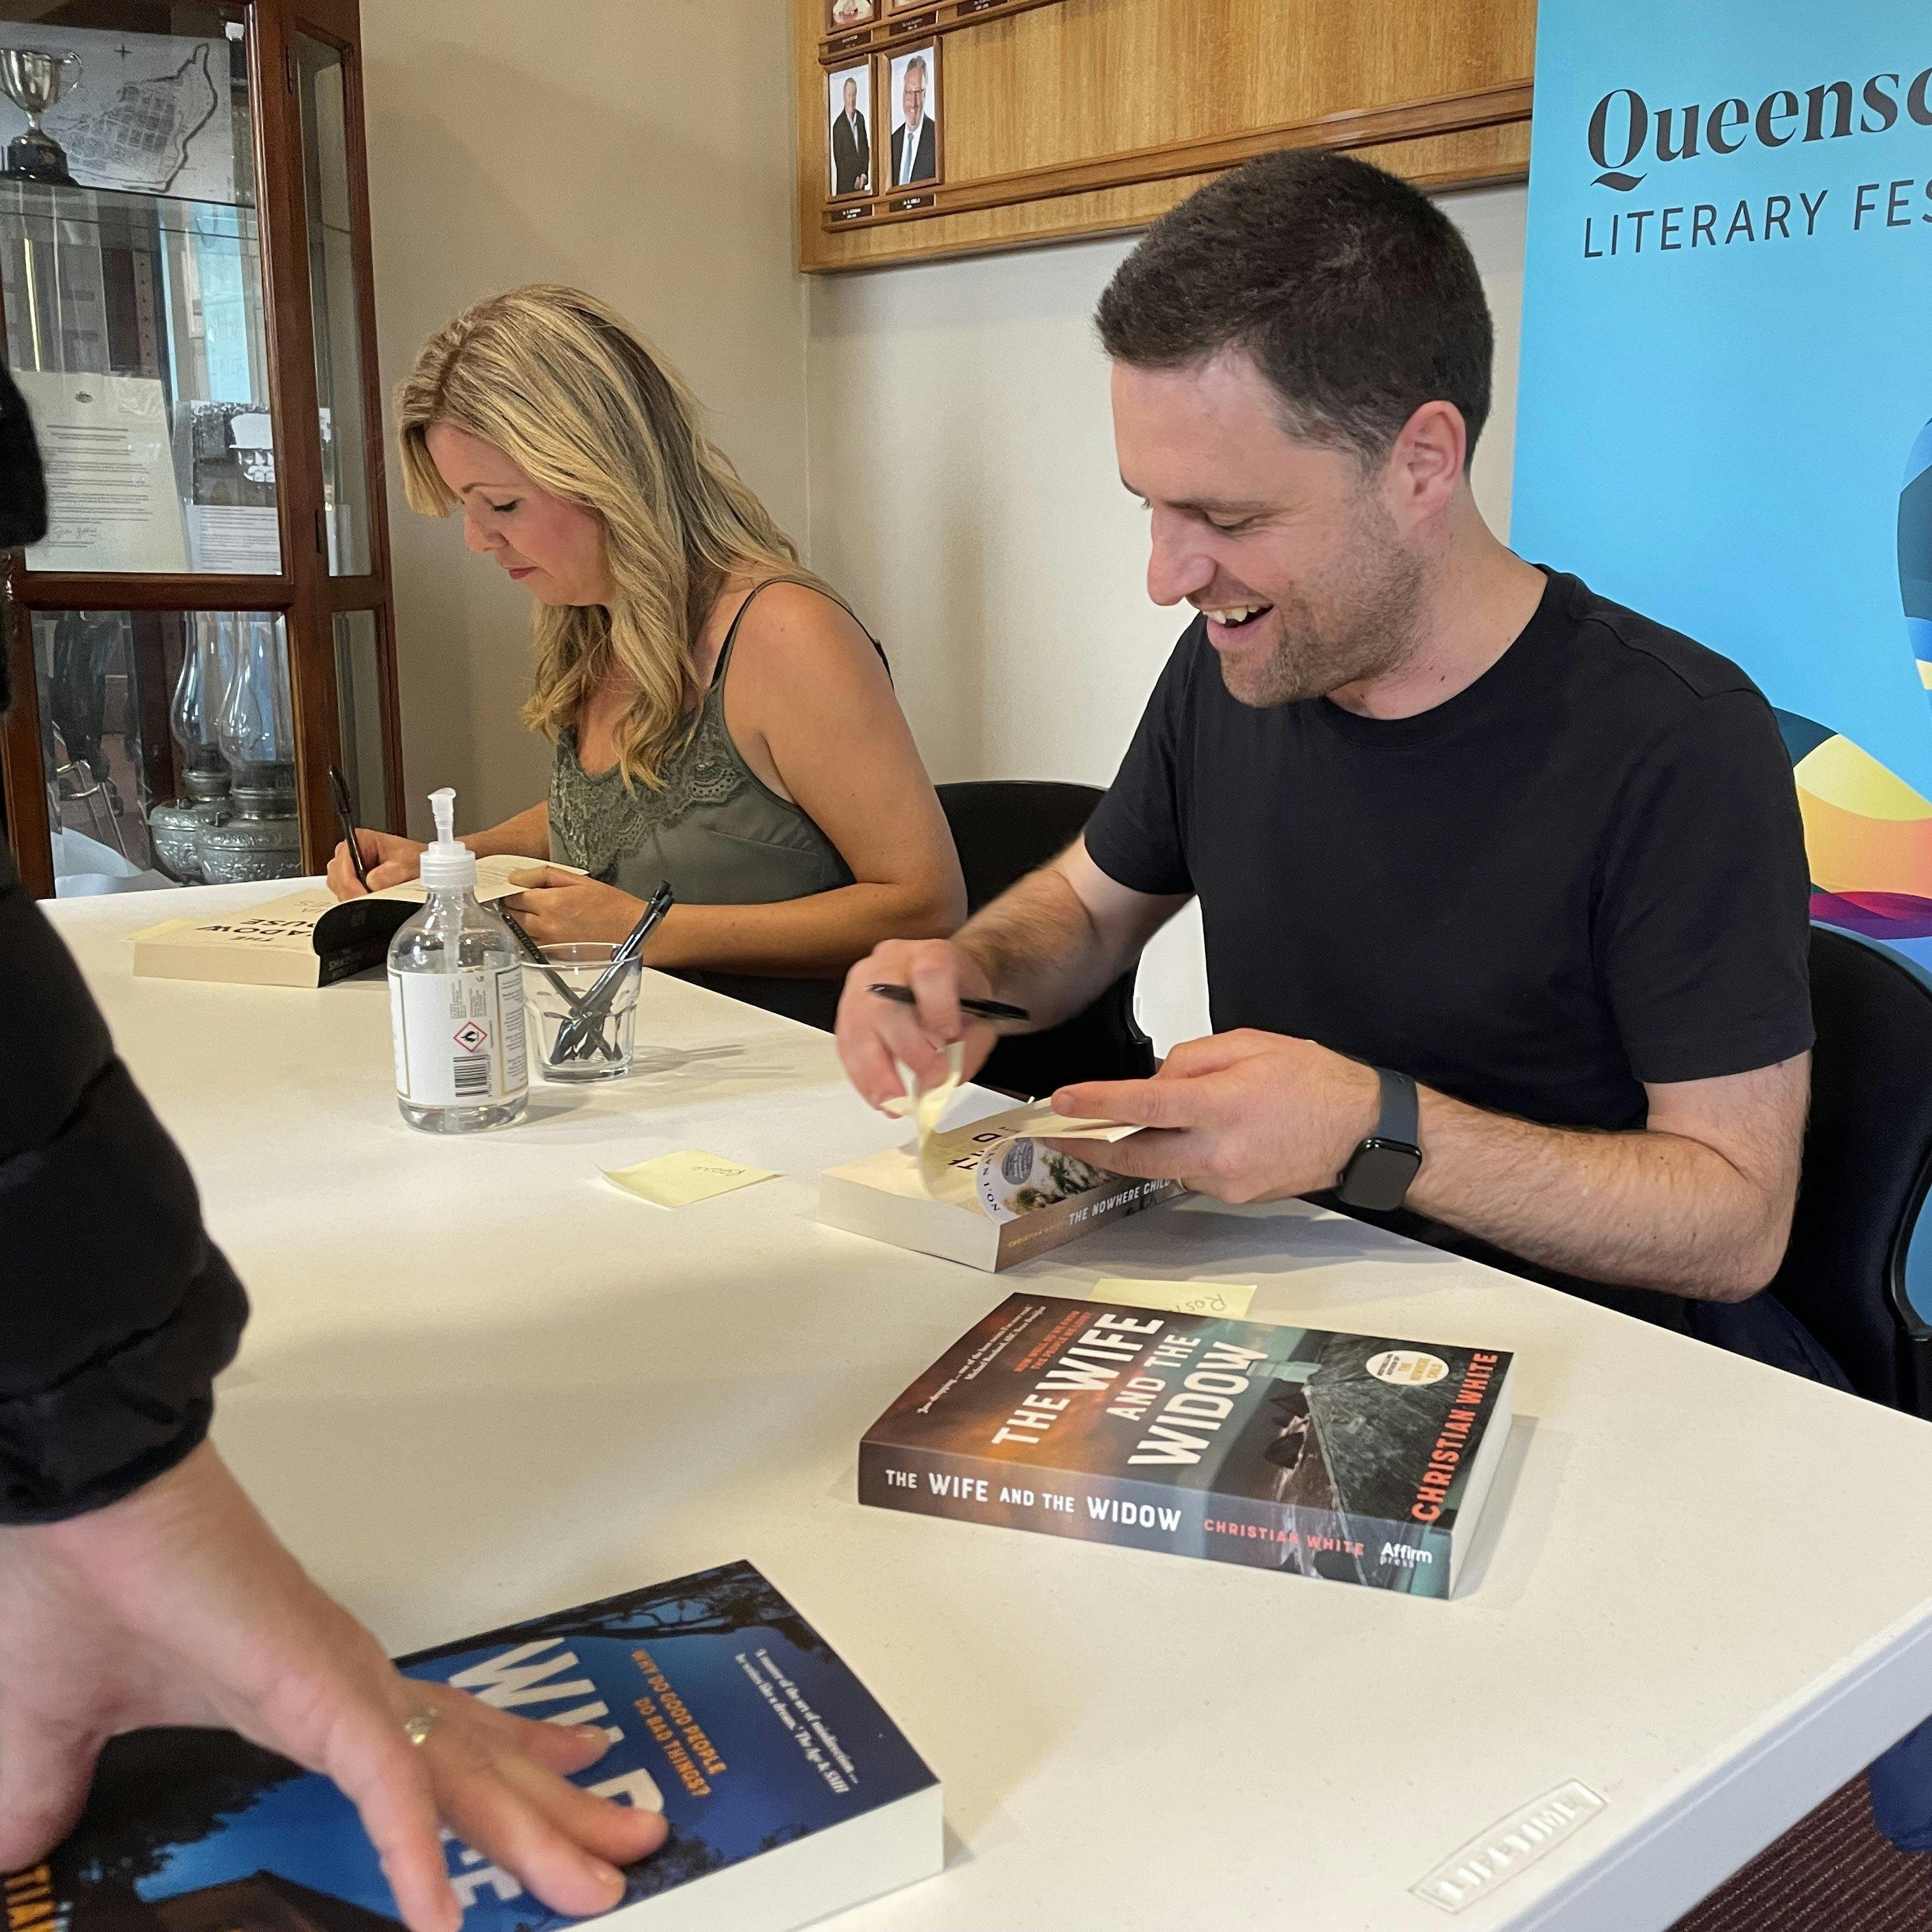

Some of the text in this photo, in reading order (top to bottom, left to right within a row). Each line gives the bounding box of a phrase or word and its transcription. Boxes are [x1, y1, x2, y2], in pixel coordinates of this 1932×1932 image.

[1584, 190, 1828, 258] LITERARY
[1069, 1207, 1089, 1227] THE
[1092, 1186, 1141, 1216] NOWHERE
[992, 1393, 1070, 1445] THE
[1034, 1313, 1165, 1392] WIFE
[1106, 1333, 1202, 1422] AND THE
[1127, 1341, 1269, 1466] WIDOW
[1412, 1351, 1498, 1523] CHRISTIAN WHITE
[885, 1469, 1365, 1558] THE WIFE AND THE WIDOW CHRISTIAN WHITE
[1381, 1541, 1433, 1565] Affirm
[633, 1697, 712, 1797] DO BAD THINGS?
[647, 1675, 670, 1692] DO
[660, 1692, 693, 1725] GOOD
[683, 1724, 727, 1775] PEOPLE
